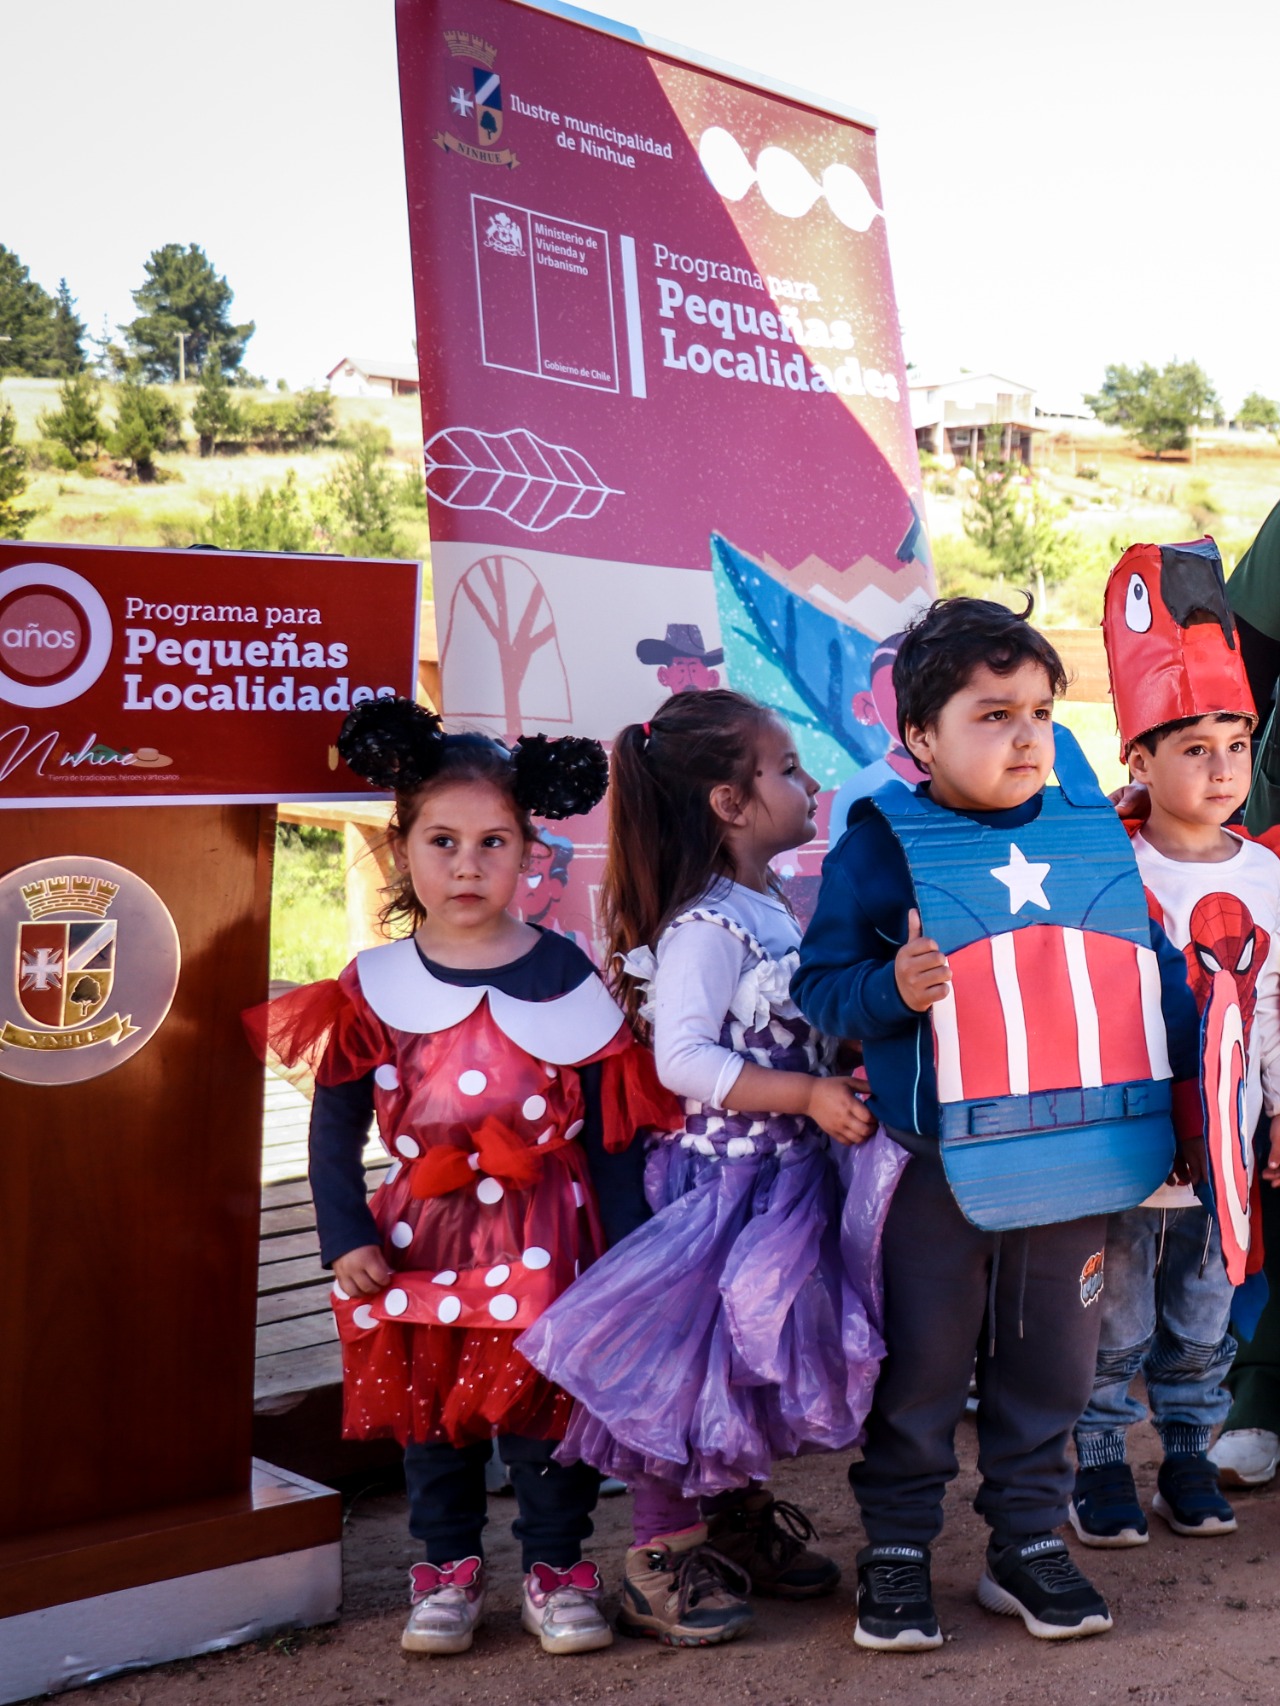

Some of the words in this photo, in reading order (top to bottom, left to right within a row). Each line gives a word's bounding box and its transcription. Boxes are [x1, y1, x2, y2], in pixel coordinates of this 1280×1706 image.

[510, 94, 560, 125] Ilustre
[564, 115, 673, 159] municipalidad
[457, 142, 501, 163] NINHUE
[556, 132, 576, 150] de
[580, 137, 636, 168] Ninhue
[535, 222, 584, 246] Ministerio
[585, 236, 598, 249] de
[535, 237, 578, 258] Vivienda
[579, 251, 586, 263] y
[536, 252, 589, 276] Urbanismo
[653, 243, 764, 291] Programa
[766, 275, 821, 302] para
[656, 277, 855, 350] Pequeñas
[544, 359, 580, 375] Gobierno
[580, 367, 590, 377] de
[591, 370, 611, 381] Chile
[661, 327, 900, 402] Localidades
[125, 597, 258, 626] Programa
[264, 605, 322, 629] para
[3, 622, 76, 649] años
[124, 628, 349, 675] Pequeñas
[50, 774, 69, 782] Tierra
[70, 774, 78, 782] de
